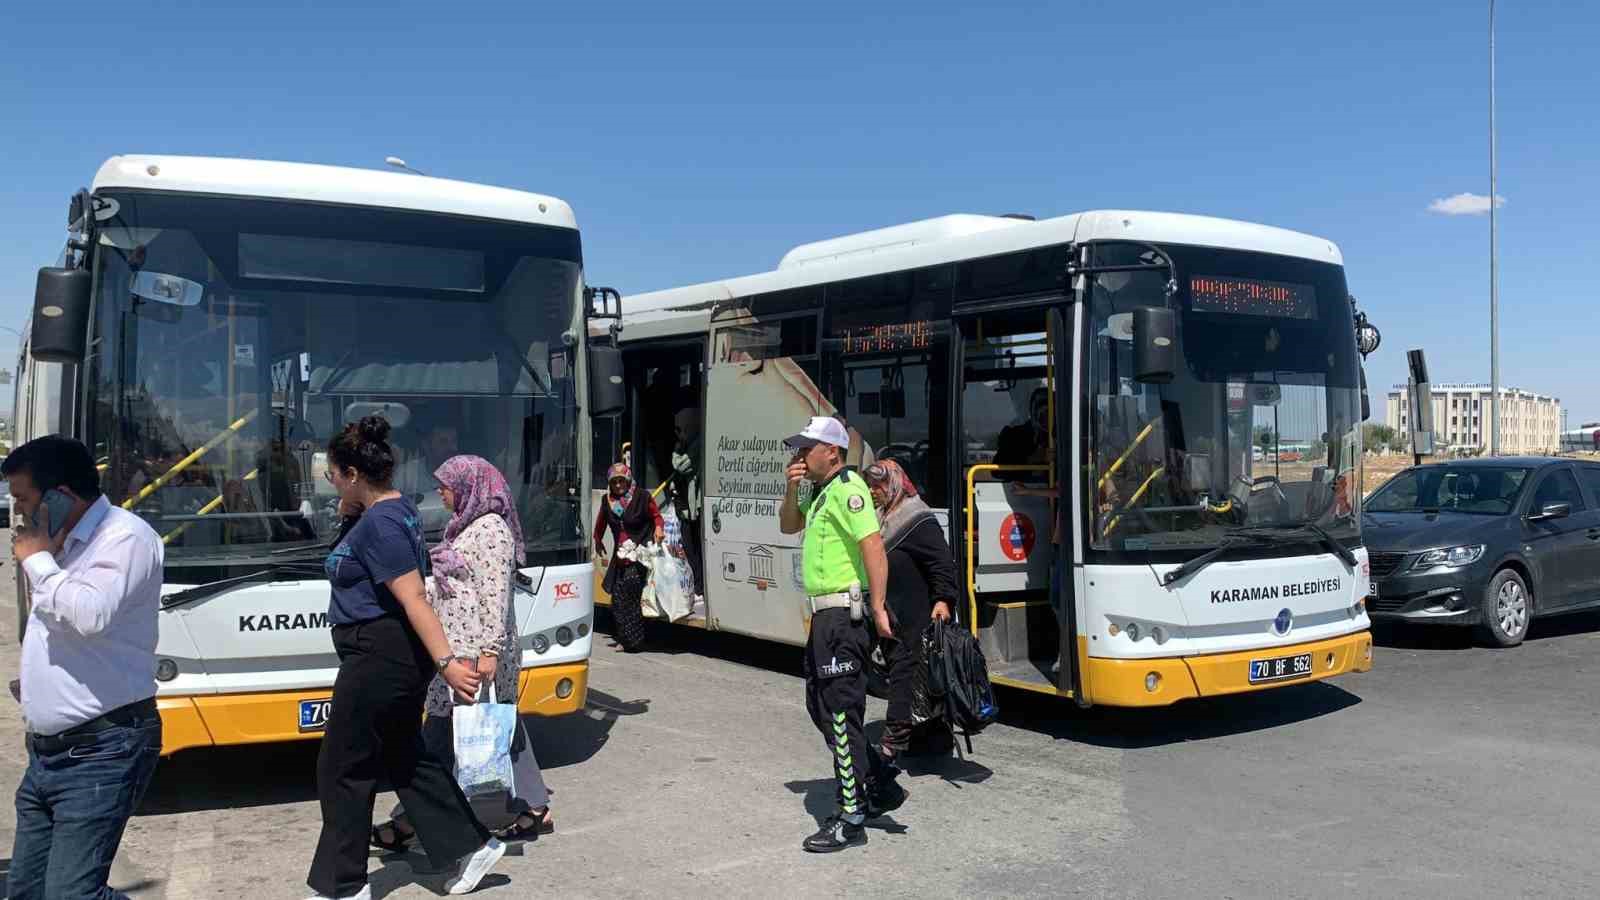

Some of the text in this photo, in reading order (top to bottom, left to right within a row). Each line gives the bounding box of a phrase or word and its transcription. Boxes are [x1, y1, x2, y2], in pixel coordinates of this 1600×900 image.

[718, 435, 740, 451] Akar
[718, 456, 784, 476] Dertli ciğerim
[754, 479, 786, 496] anuba
[719, 498, 733, 513] Gel
[736, 500, 753, 517] gör
[1211, 576, 1341, 603] KARAMAN BELEDİYESİ
[239, 612, 332, 632] KARAM
[1256, 661, 1268, 677] 70
[1294, 656, 1311, 671] 562
[311, 703, 332, 722] 70
